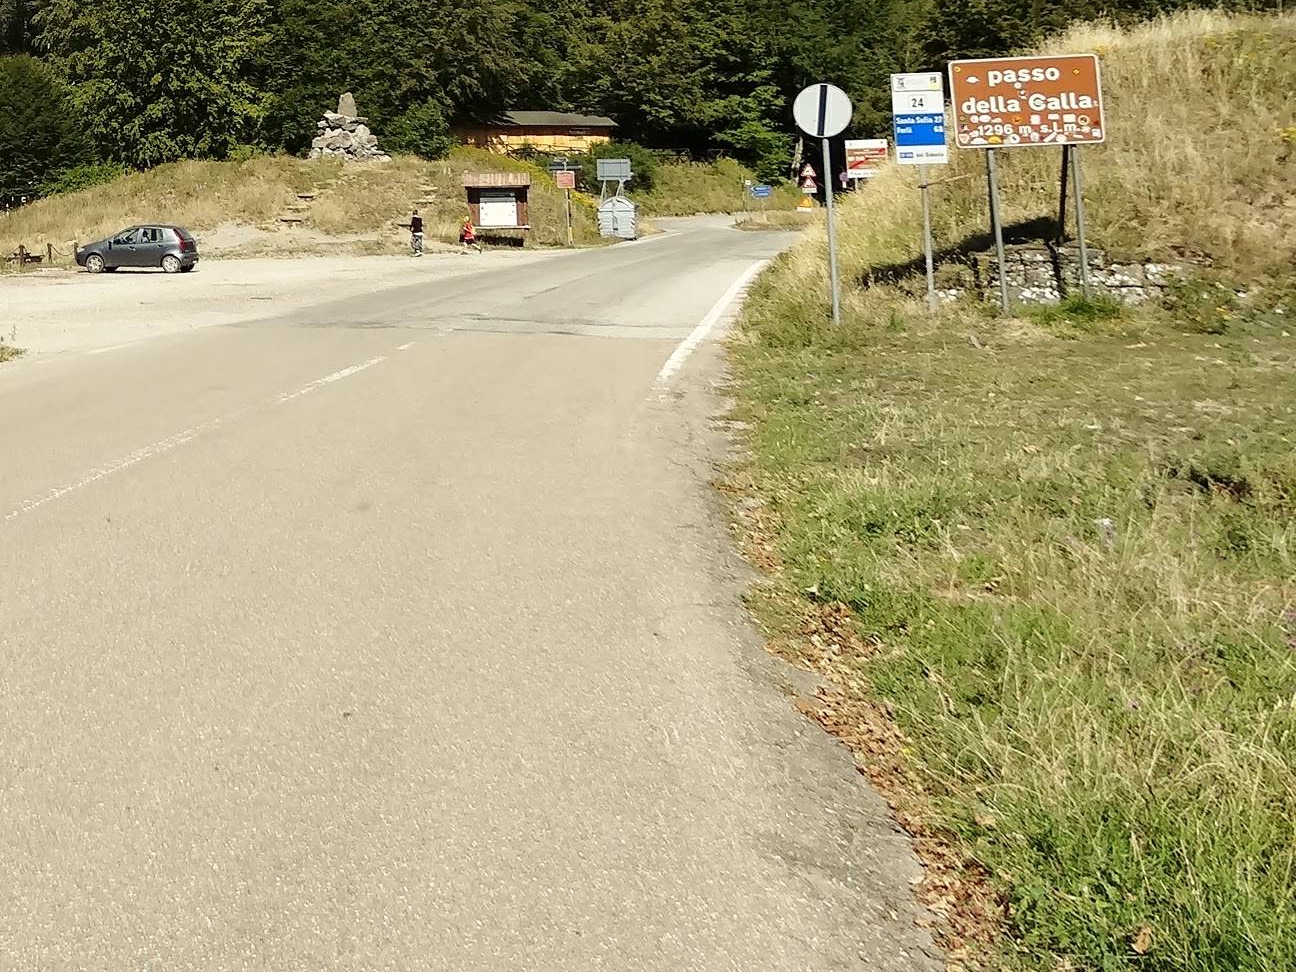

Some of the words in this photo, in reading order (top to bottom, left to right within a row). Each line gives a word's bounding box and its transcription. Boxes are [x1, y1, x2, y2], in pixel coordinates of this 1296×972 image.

[987, 67, 1060, 88] passo
[911, 97, 924, 108] 24
[961, 96, 1021, 115] della
[977, 123, 1014, 136] 1296
